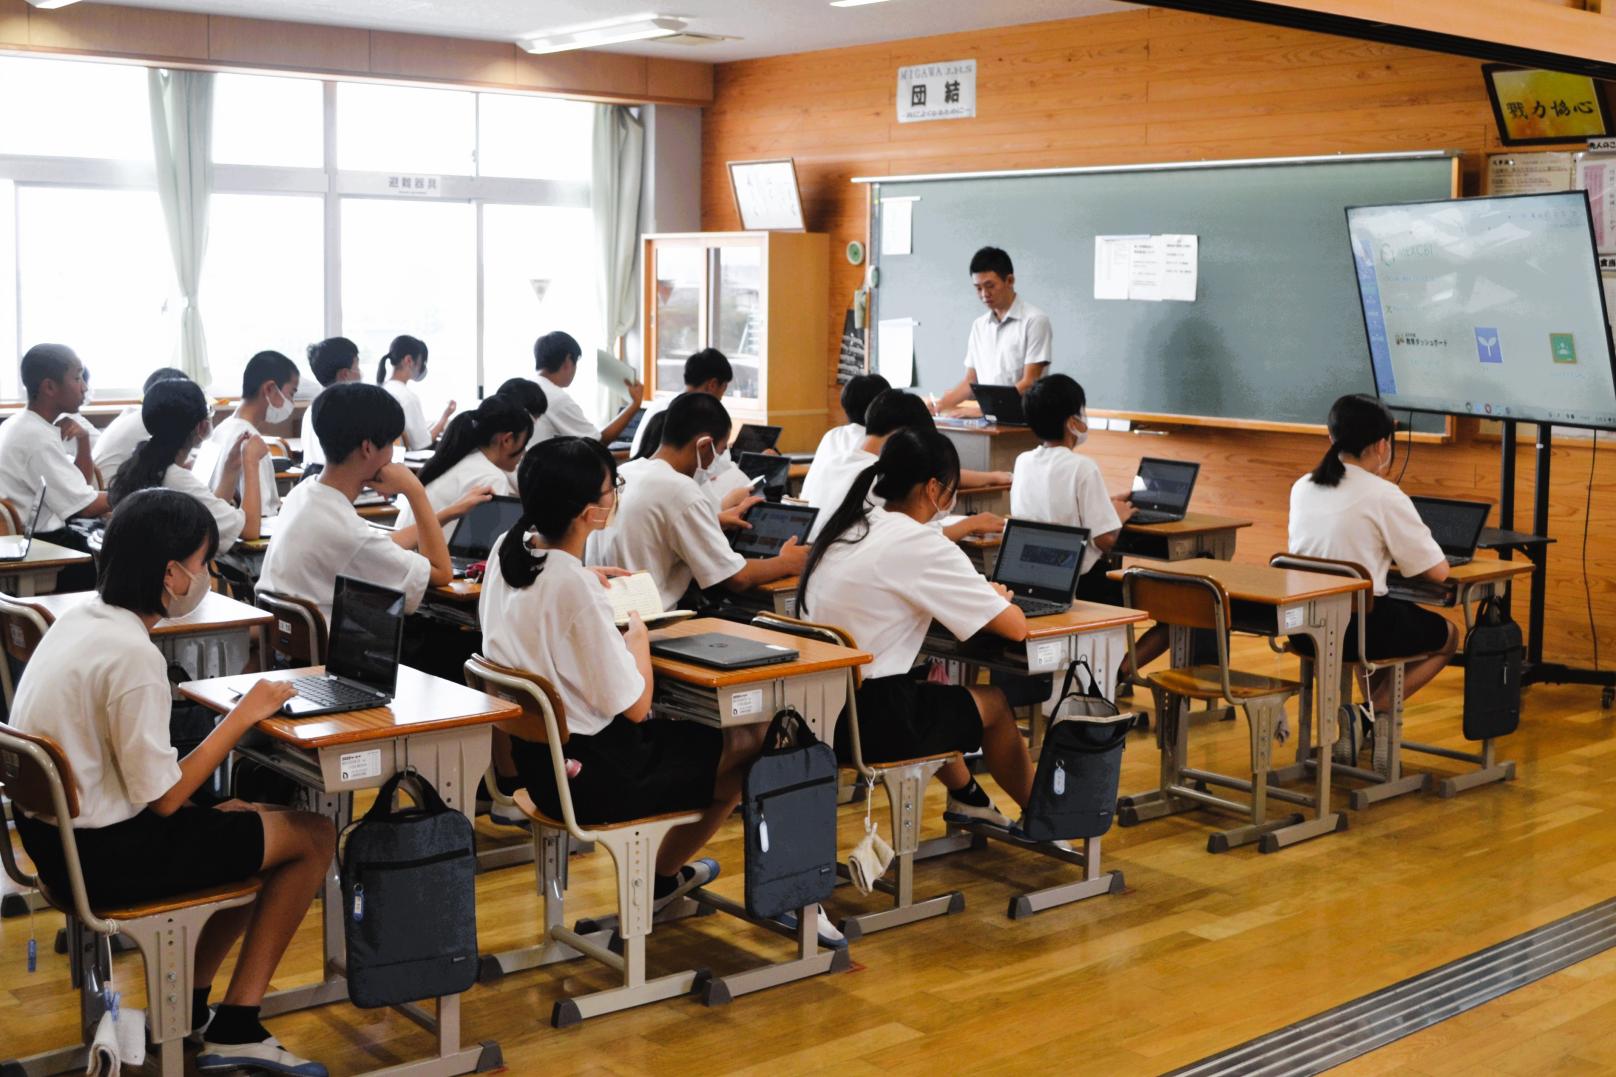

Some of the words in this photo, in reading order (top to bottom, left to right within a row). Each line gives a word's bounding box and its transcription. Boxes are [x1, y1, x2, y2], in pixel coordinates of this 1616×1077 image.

[911, 80, 960, 107] 団結
[388, 176, 437, 190] 避難器具
